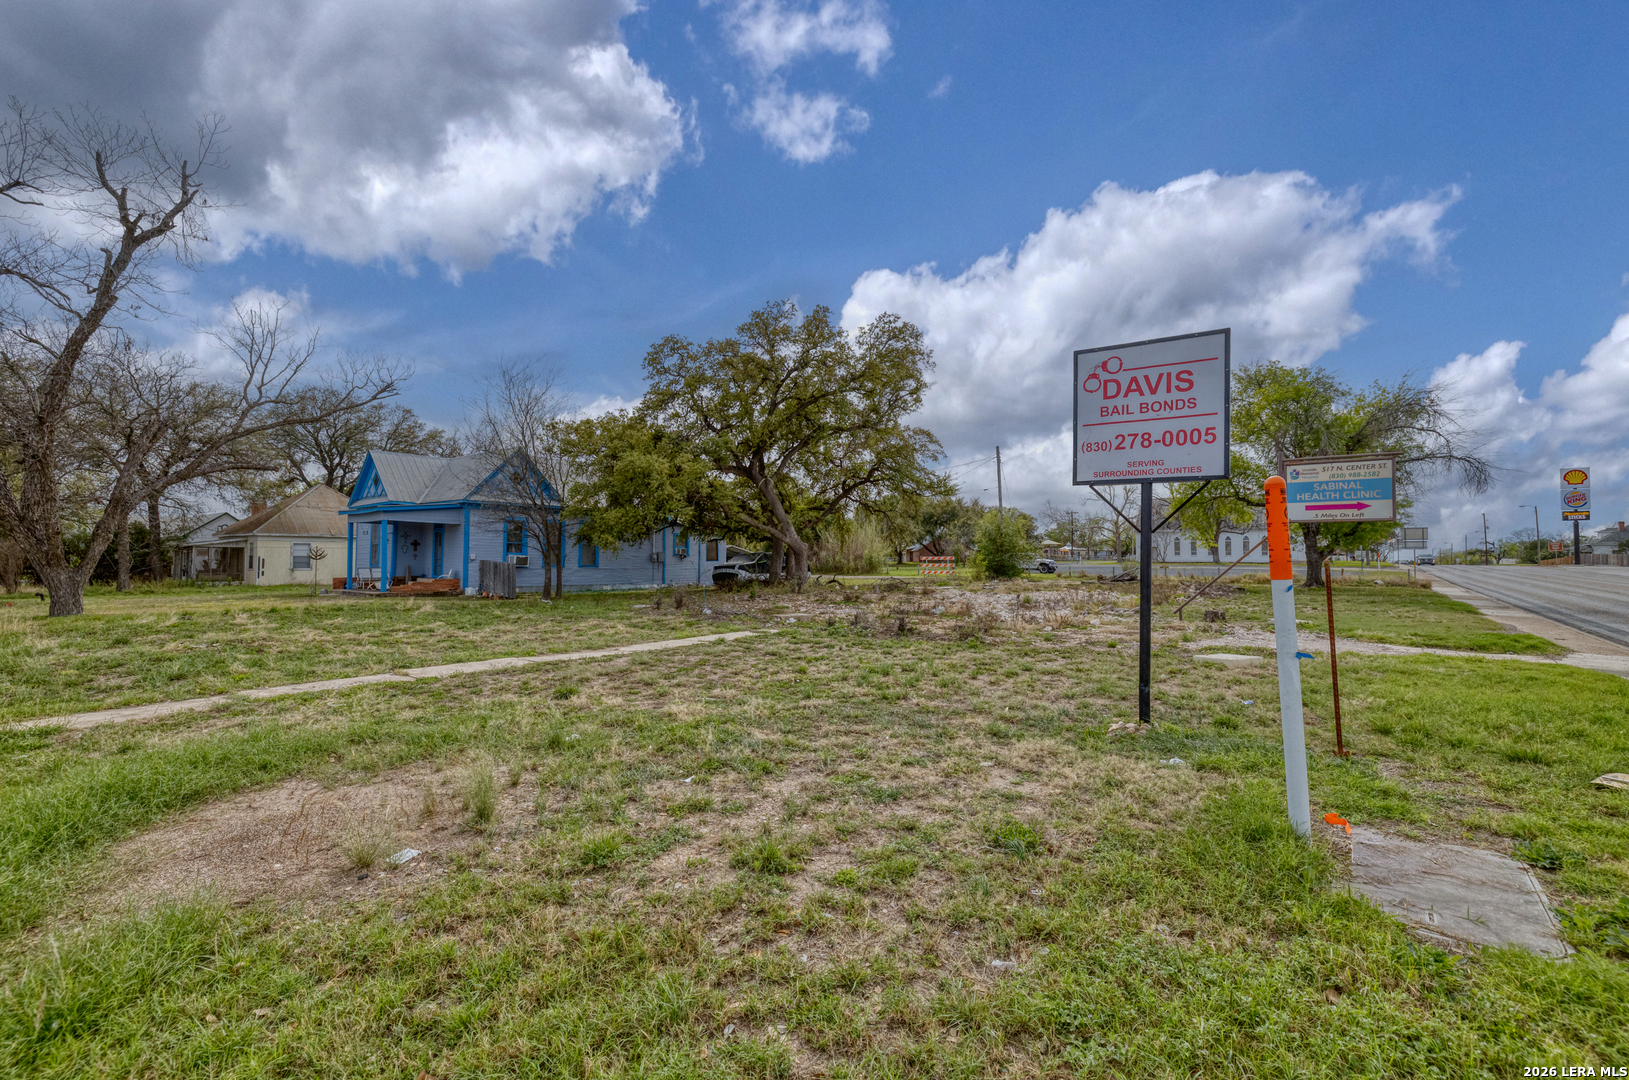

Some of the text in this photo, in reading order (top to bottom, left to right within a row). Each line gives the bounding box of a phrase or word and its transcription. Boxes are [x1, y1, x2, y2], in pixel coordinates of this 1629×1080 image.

[1103, 370, 1194, 400] DAVIS
[1100, 397, 1197, 417] BAIL BONDS
[1081, 427, 1217, 454] (830) 278-0005
[1127, 459, 1164, 468] SERVING
[1093, 466, 1202, 478] SURROUNDING COUNTIES
[1314, 481, 1363, 491] SABINAL
[1296, 492, 1340, 501] HEALTH
[1343, 490, 1382, 499] CLINIC
